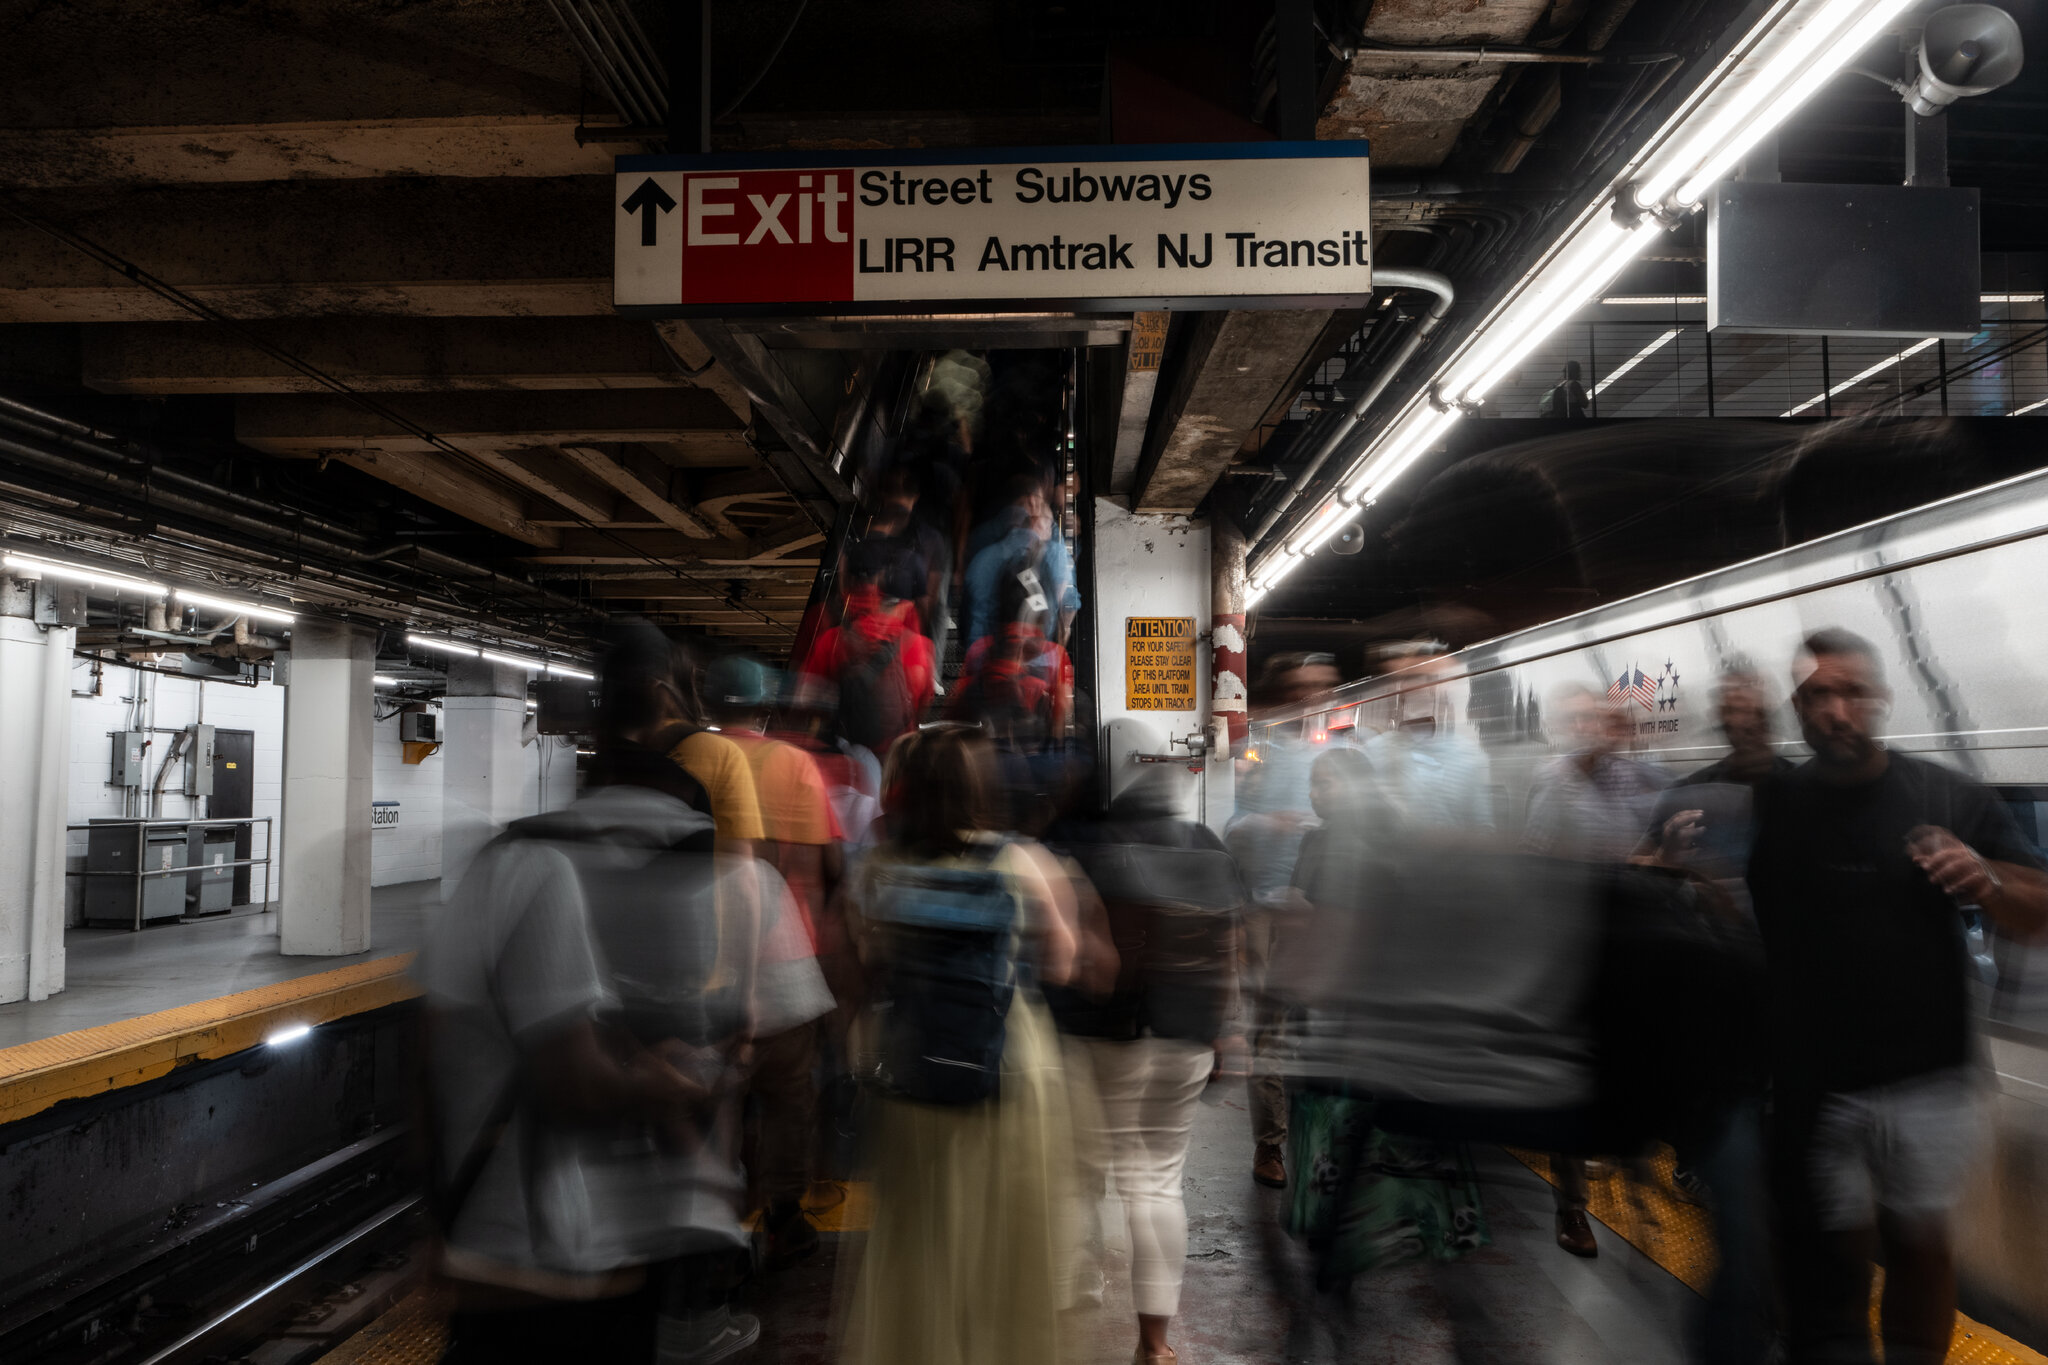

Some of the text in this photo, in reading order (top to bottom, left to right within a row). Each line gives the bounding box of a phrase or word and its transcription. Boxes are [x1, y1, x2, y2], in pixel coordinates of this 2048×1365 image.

[859, 166, 1212, 209] Street Subways
[687, 172, 848, 247] Exit
[859, 230, 1368, 273] LIRR Amtrak NJ Transit
[1130, 620, 1192, 637] ATTENTION
[1132, 641, 1145, 652] FOR
[1147, 641, 1164, 652] YOUR
[1130, 655, 1192, 666] PLEASE STAY CLEAR
[1132, 669, 1191, 680] OF THIS PLATFORM
[1134, 684, 1189, 694] AREA UNTIL TRAIN
[1131, 697, 1151, 709] STOPS
[1153, 698, 1163, 708] ON
[1164, 698, 1185, 709] TRACK
[1639, 721, 1656, 734] WITH
[1658, 719, 1679, 733] PRIDE
